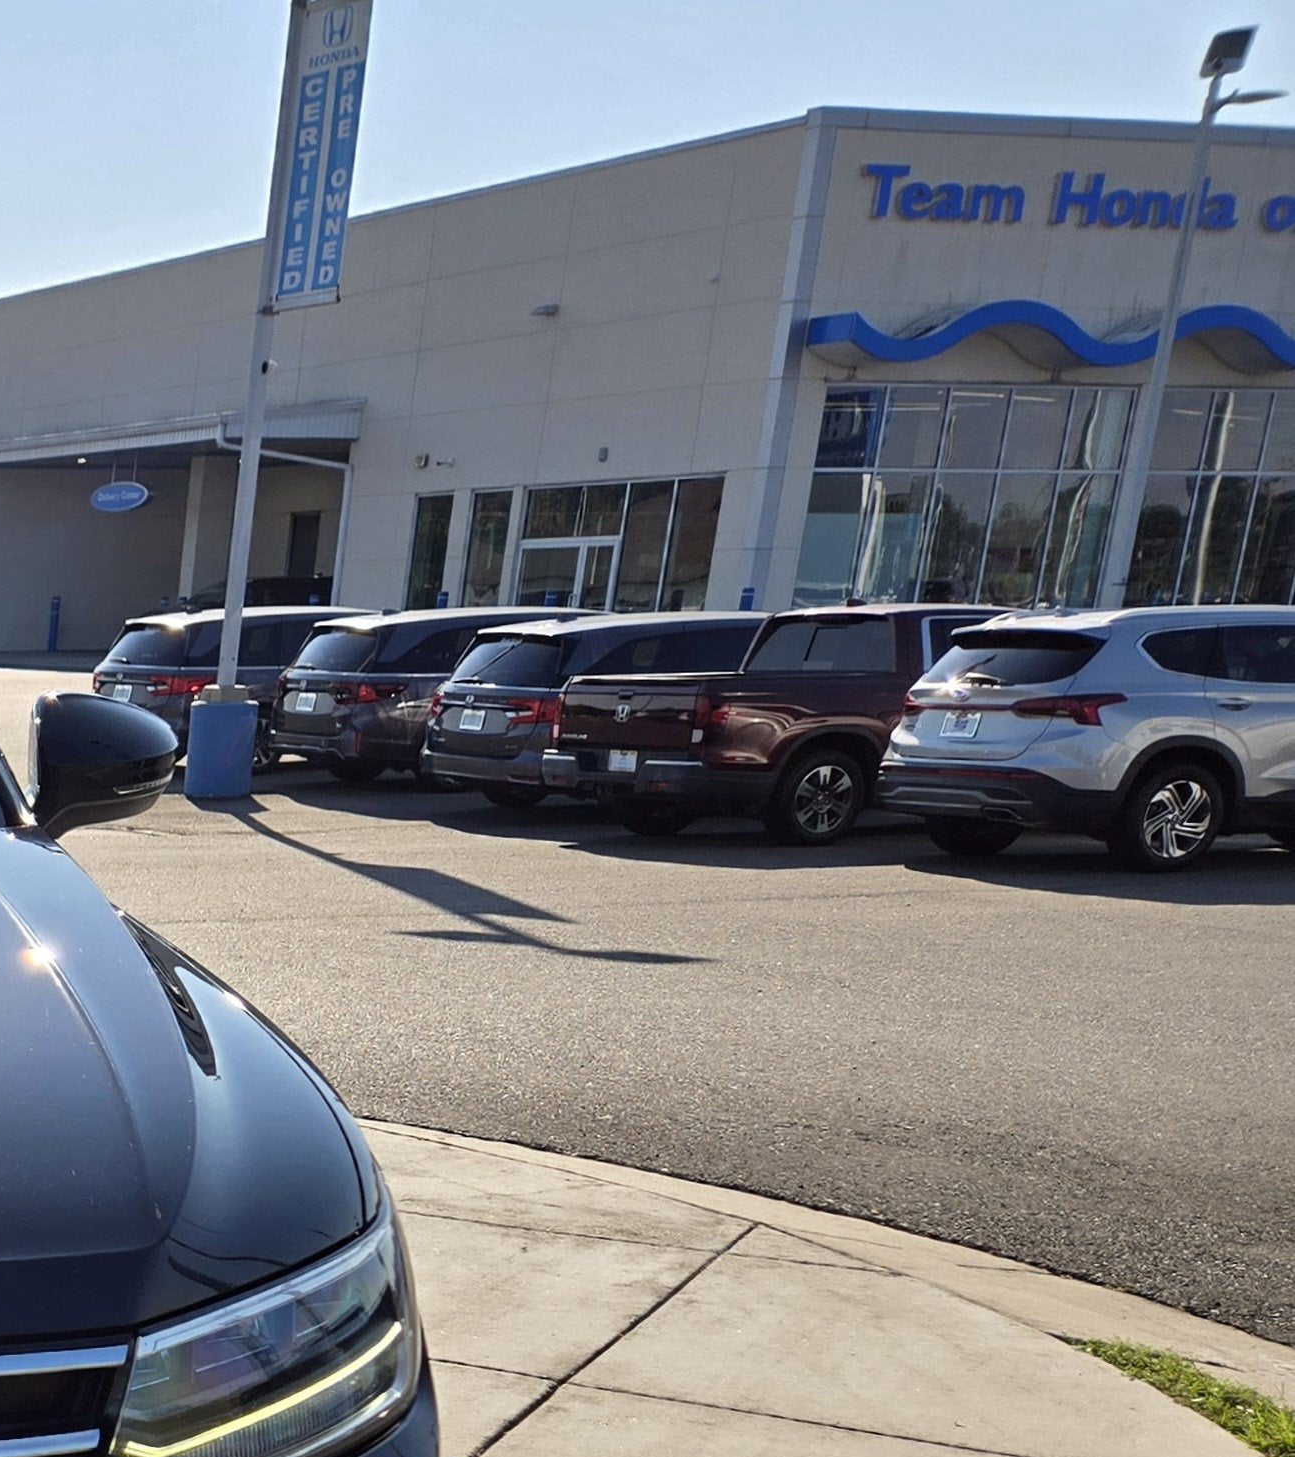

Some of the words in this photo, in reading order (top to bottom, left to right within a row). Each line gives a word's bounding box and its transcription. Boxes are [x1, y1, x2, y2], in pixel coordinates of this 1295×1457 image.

[309, 46, 360, 68] HONDA
[337, 67, 358, 139] PRE
[282, 77, 324, 291] CERTIFIED
[861, 163, 1025, 224] Team
[1048, 171, 1239, 231] Honda
[318, 167, 348, 285] OWNED
